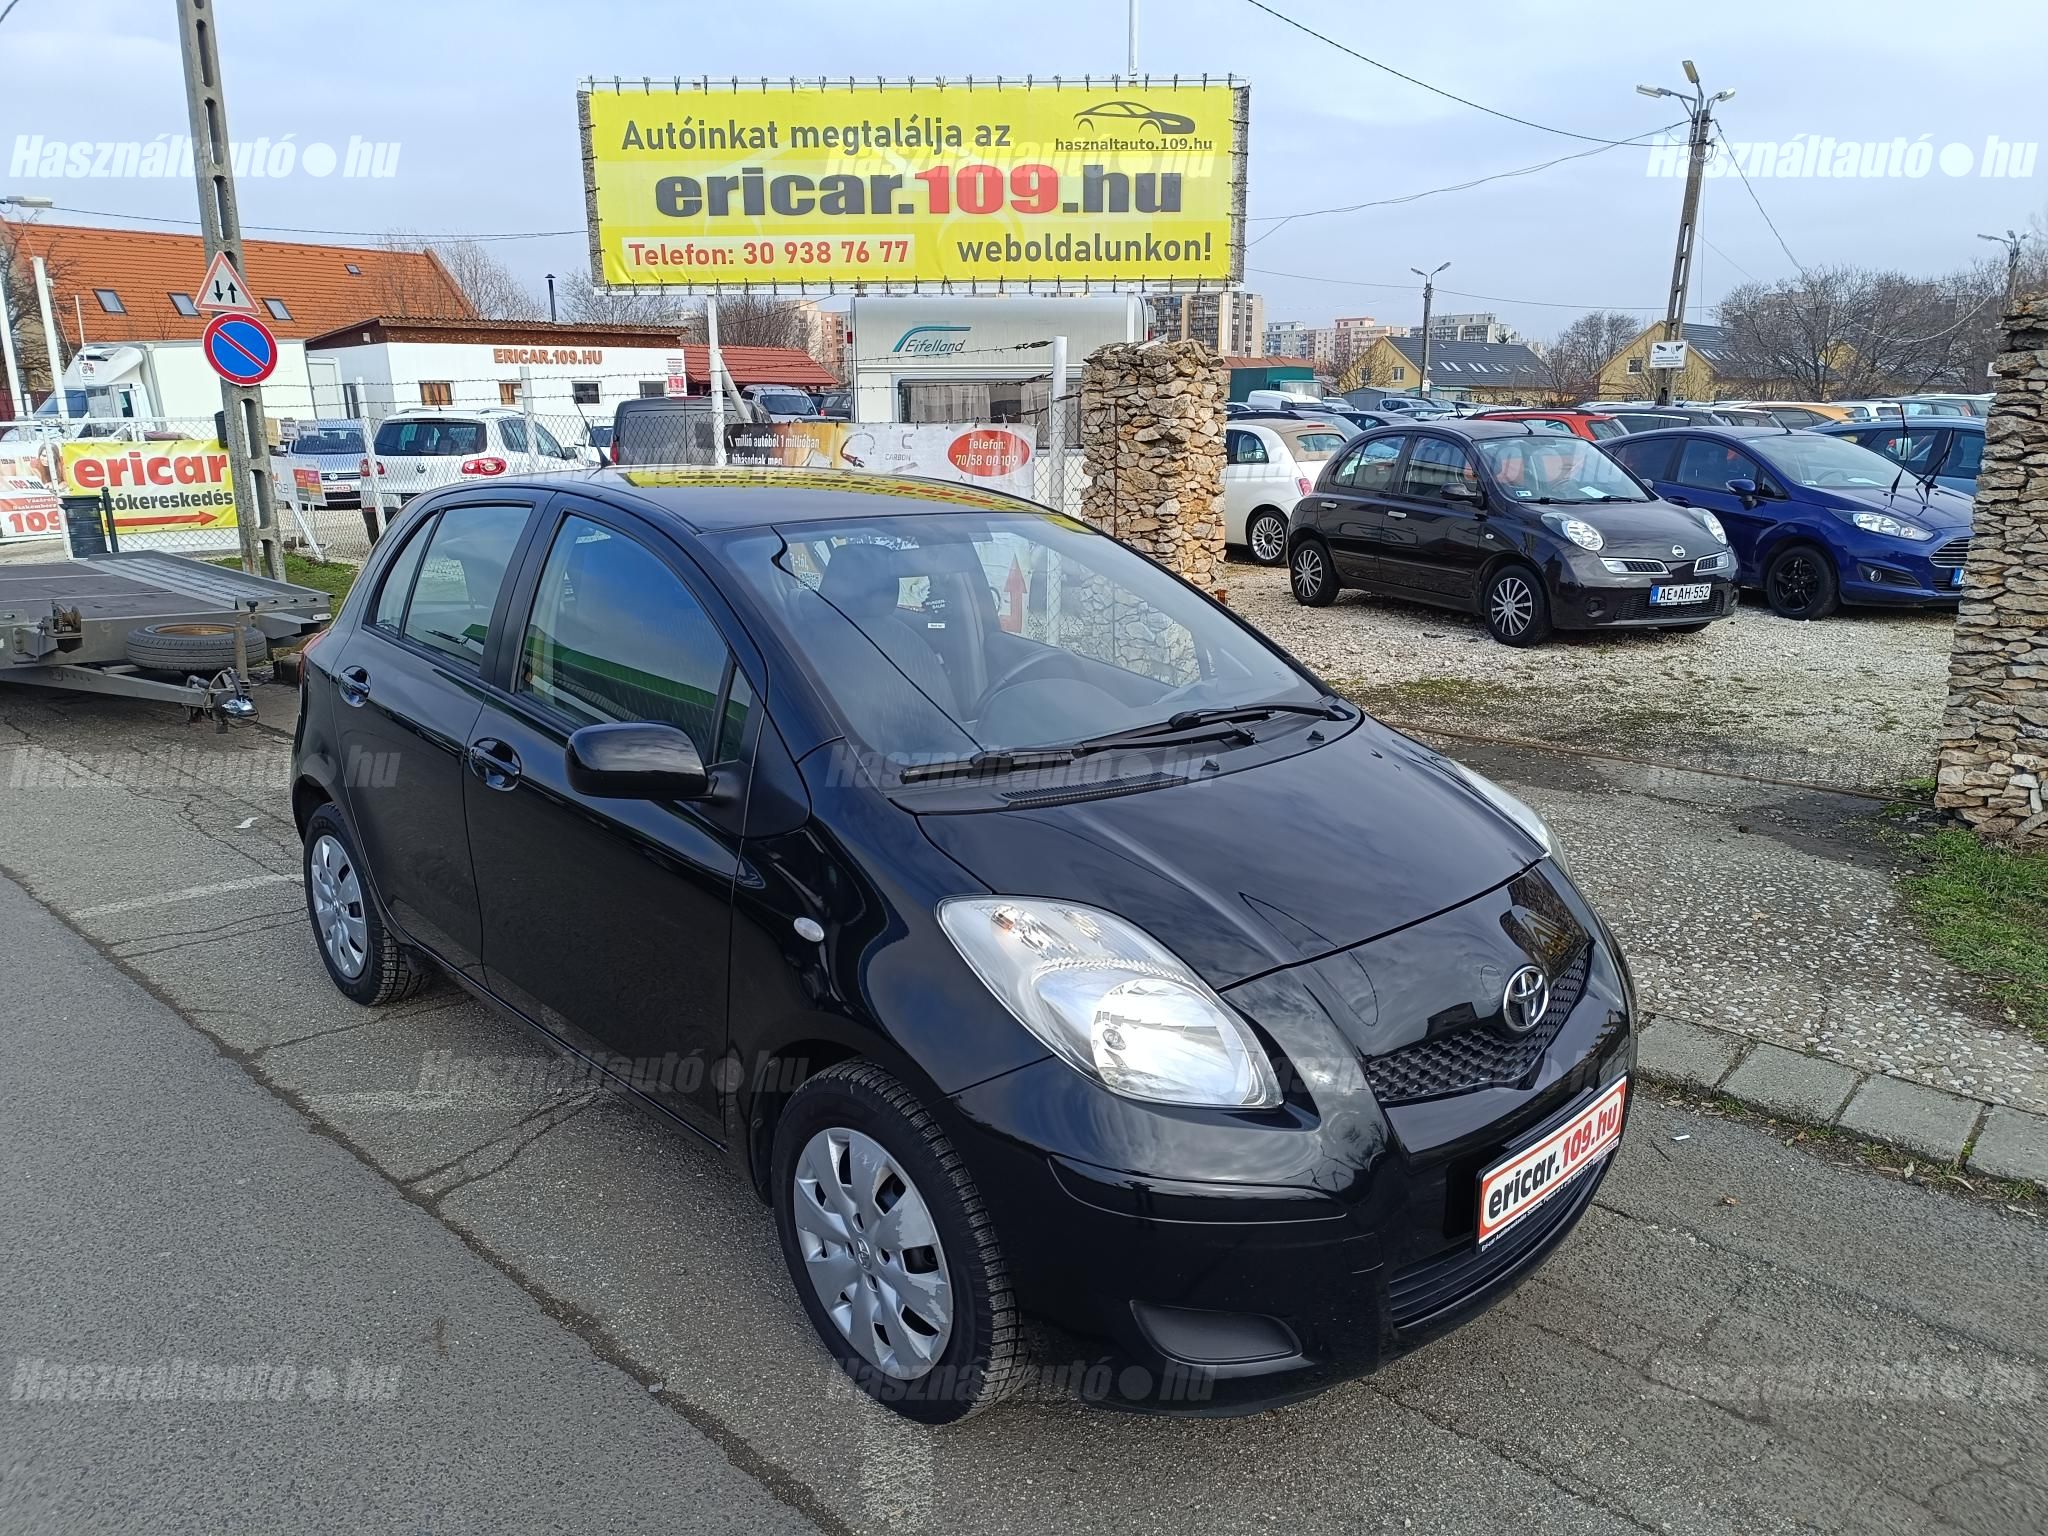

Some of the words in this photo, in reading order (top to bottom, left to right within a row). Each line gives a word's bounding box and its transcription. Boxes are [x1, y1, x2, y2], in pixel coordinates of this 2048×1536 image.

[622, 116, 778, 150] Autóinkat
[791, 114, 962, 155] megtalálja
[975, 124, 1011, 147] az
[1055, 138, 1213, 151] hasznaltauto.109.hu
[655, 163, 1182, 217] ericar.109.hu
[628, 243, 735, 266] Telefon:
[743, 242, 775, 265] 30
[784, 241, 832, 264] 938
[841, 241, 870, 264] 76
[879, 240, 909, 263] 77
[956, 232, 1212, 263] weboldalunkon!
[494, 348, 603, 365] ERICAR.109.HU
[905, 338, 966, 352] Eifelland
[969, 438, 1006, 450] Telefon:
[74, 451, 228, 488] ericar
[1488, 1102, 1618, 1220] ericar.109.hu
